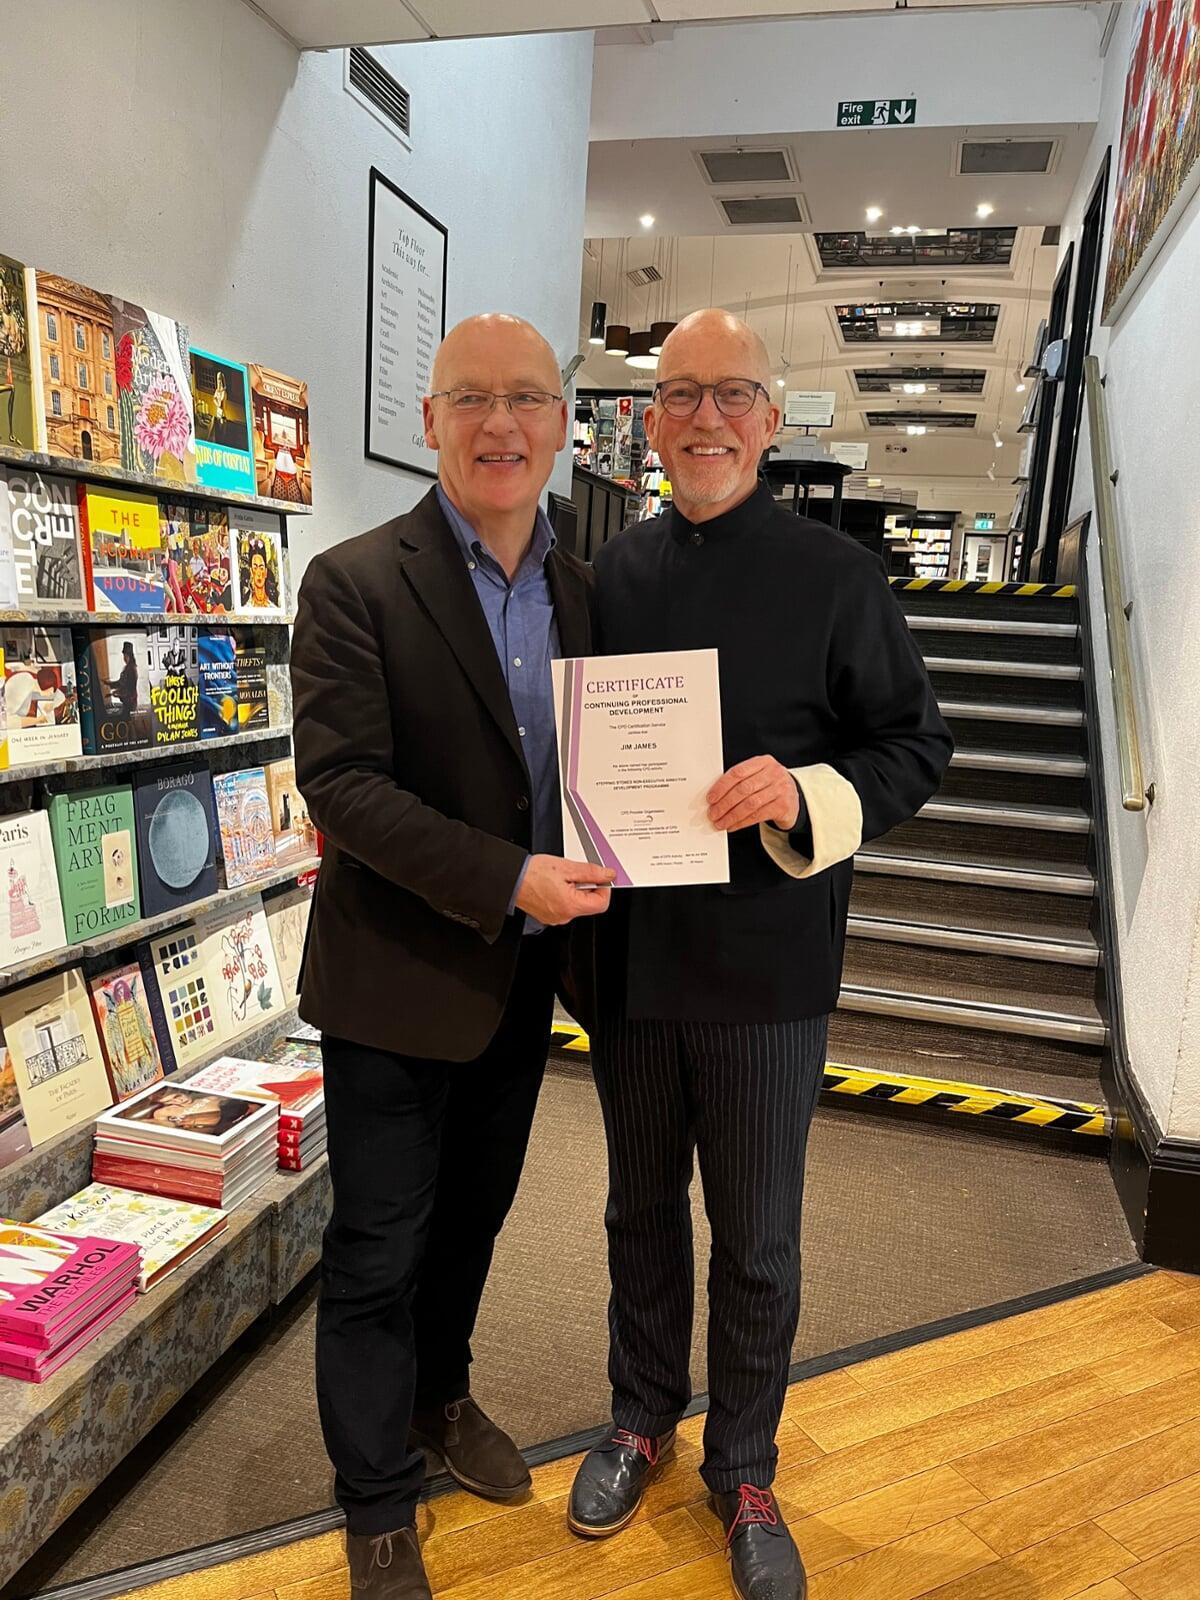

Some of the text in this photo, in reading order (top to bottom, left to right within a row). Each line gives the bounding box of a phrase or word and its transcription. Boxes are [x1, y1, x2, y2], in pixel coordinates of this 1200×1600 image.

[842, 102, 864, 113] Fire
[841, 114, 861, 125] exit
[392, 241, 405, 260] This
[398, 228, 426, 257] Top Floor
[130, 344, 171, 374] Modern
[110, 509, 140, 527] THE
[100, 542, 155, 561] ICONIC
[104, 576, 156, 593] HOUSE
[200, 662, 235, 671] ART WITHOUT
[204, 671, 232, 681] FRONTIERS
[165, 674, 185, 687] THESE
[586, 676, 685, 694] CERTIFICATE
[151, 685, 199, 705] FOOLISH
[584, 697, 688, 709] CONTINUING PROFESSIONAL
[154, 704, 196, 724] THINGS
[609, 707, 664, 716] DEVELOPMENT
[157, 730, 180, 742] DYLAN
[181, 728, 198, 739] JONES
[634, 742, 657, 750] JAMES
[157, 770, 195, 790] BORAGÓ
[66, 795, 116, 822] FRAG
[68, 817, 122, 847] MENT
[68, 847, 103, 872] ARY
[74, 902, 136, 935] FORMS
[16, 1245, 121, 1312] WARHOL
[36, 1266, 108, 1316] THE TEXTILES
